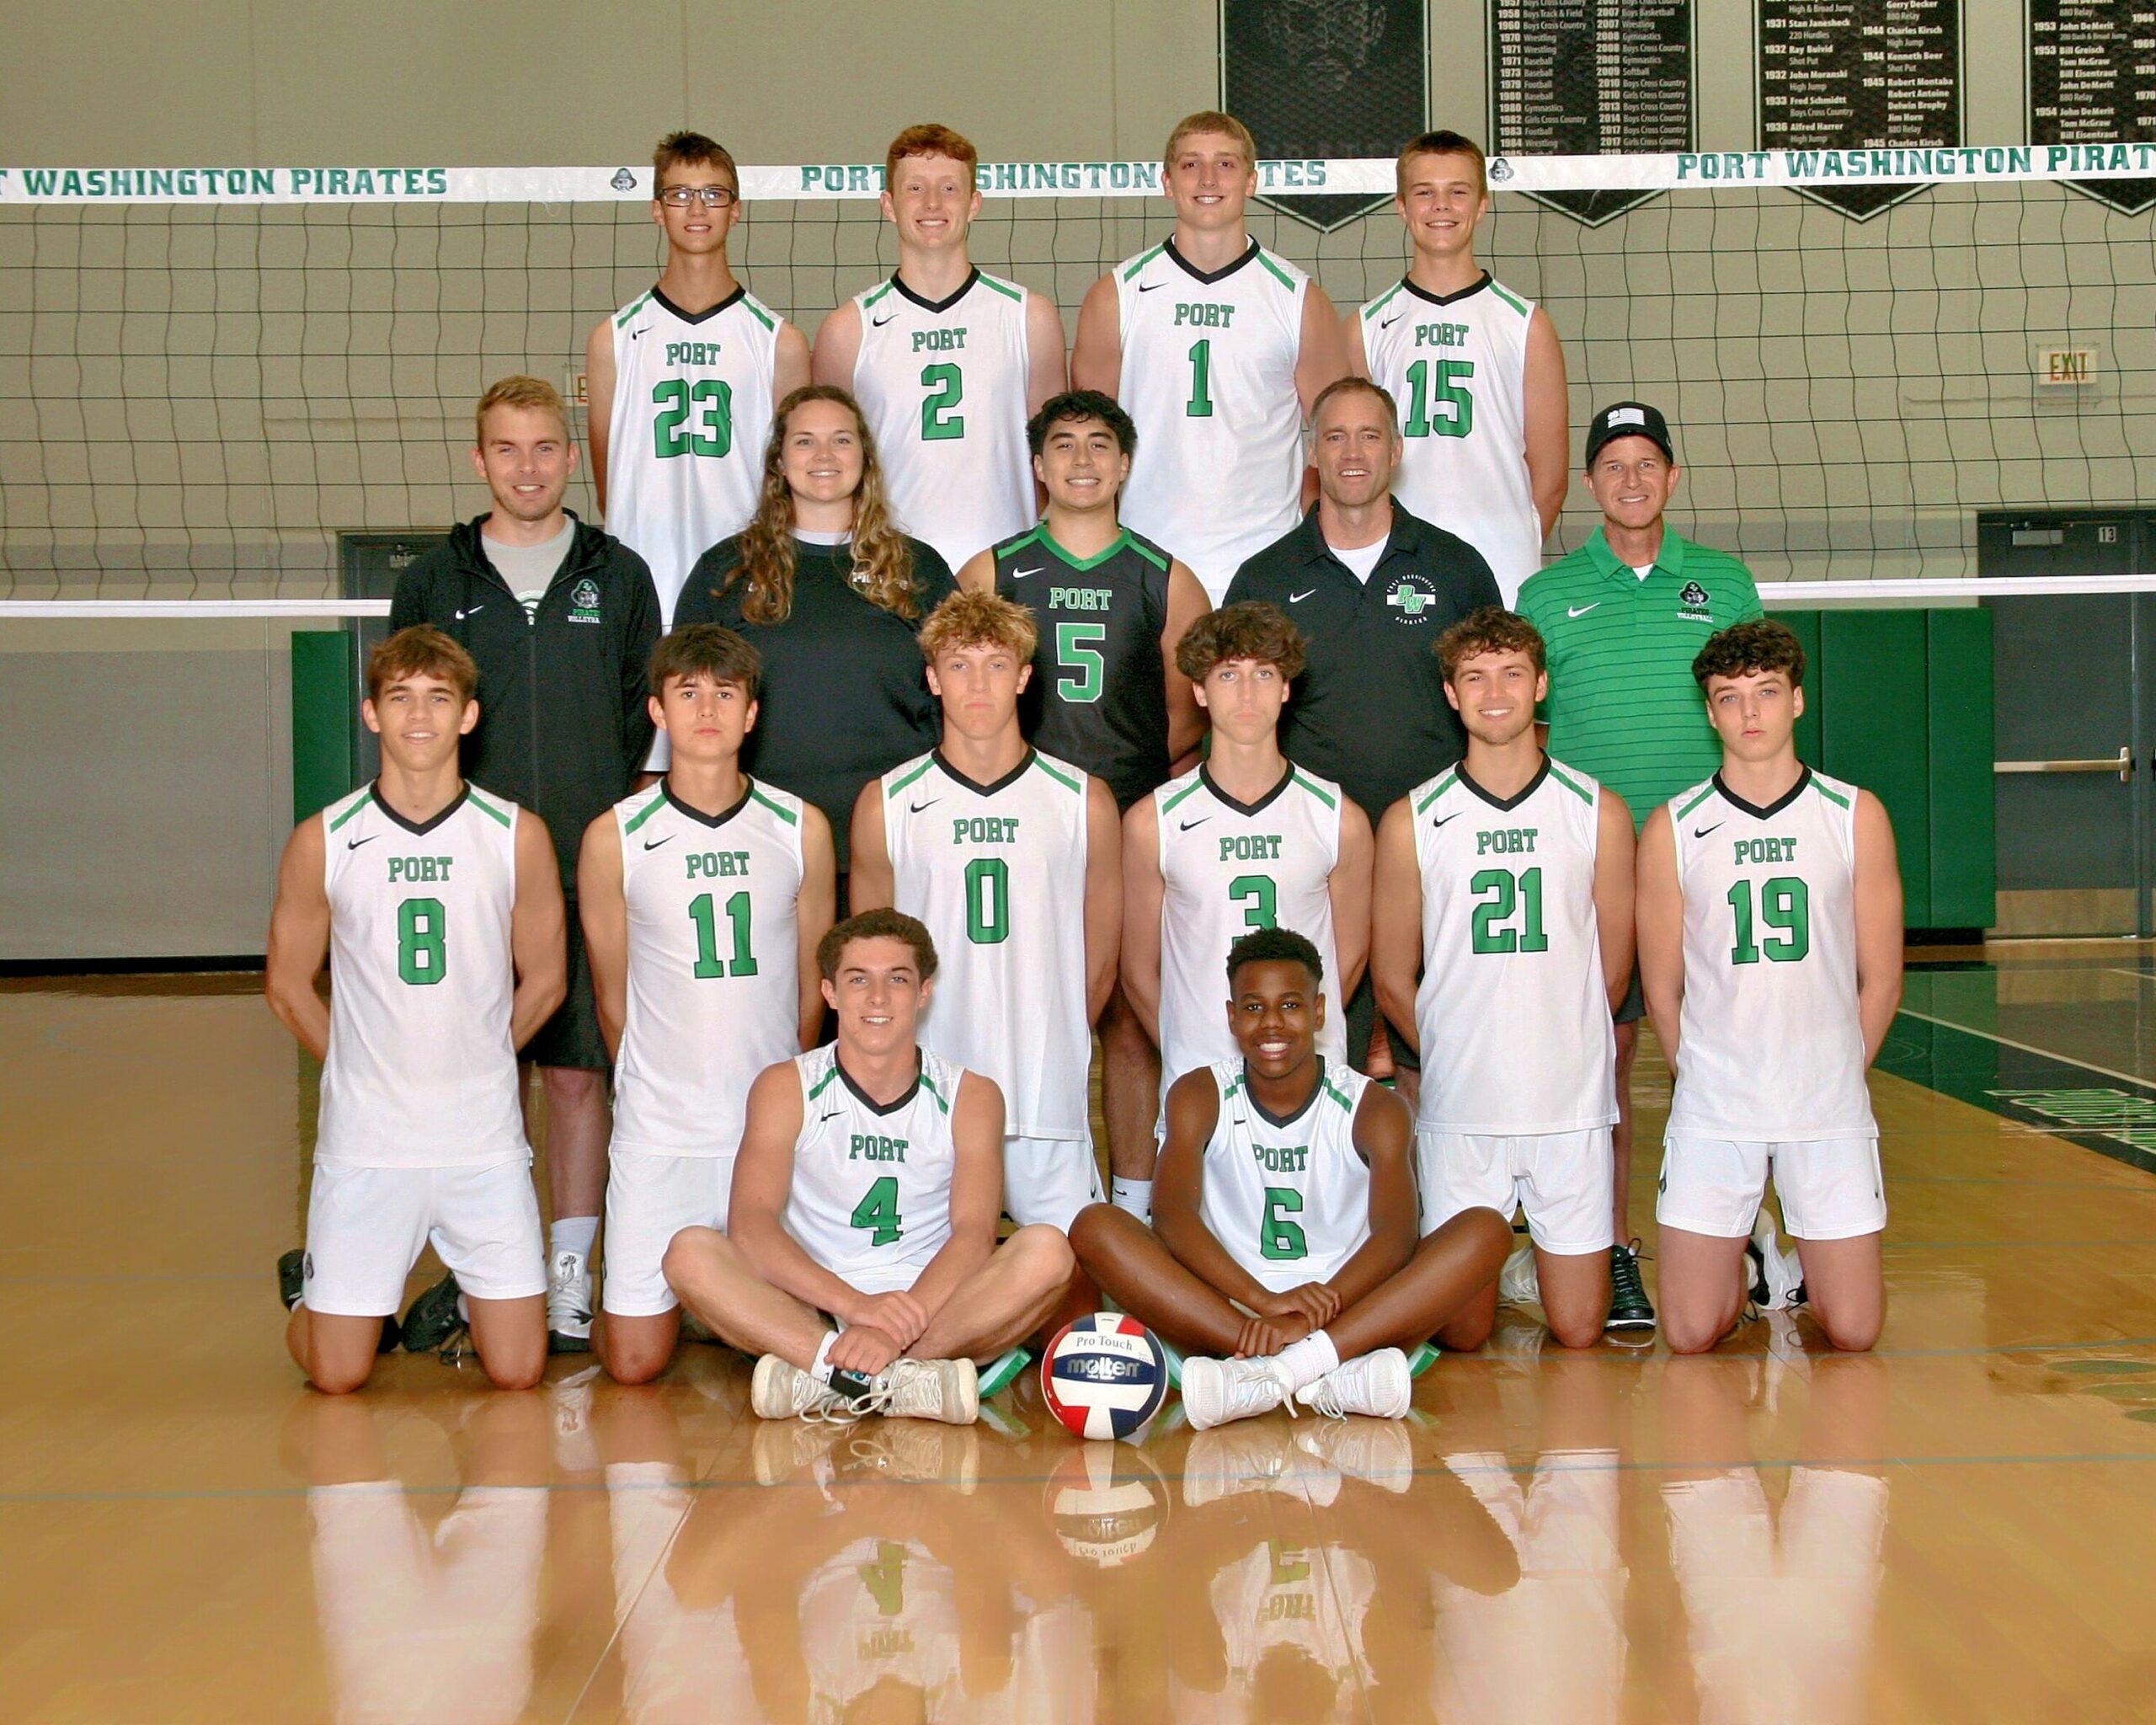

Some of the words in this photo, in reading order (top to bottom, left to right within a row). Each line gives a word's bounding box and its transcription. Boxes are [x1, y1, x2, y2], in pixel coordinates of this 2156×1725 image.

[1597, 8, 1620, 17] 2007
[1597, 19, 1619, 29] 2007
[1789, 19, 1808, 28] Stan
[1887, 26, 1917, 35] Charles
[1918, 25, 1943, 34] Kirsch
[2034, 21, 2056, 31] 1953
[2059, 22, 2079, 31] John
[1501, 45, 1521, 54] 1971
[1764, 45, 1786, 54] 1932
[1789, 45, 1805, 55] Ray
[1887, 52, 1922, 61] Kenneth
[2034, 45, 2056, 55] 1953
[2059, 46, 2073, 55] Bill
[1502, 56, 1521, 66] 1971
[2059, 58, 2077, 67] Tom
[2078, 57, 2111, 66] McGraw
[1500, 68, 1521, 77] 1973
[1765, 71, 1787, 79] 1932
[1790, 71, 1809, 79] John
[2059, 70, 2073, 78] Bill
[1598, 78, 1620, 88] 2010
[1659, 78, 1687, 88] Country
[2059, 82, 2079, 90] John
[1598, 90, 1620, 99] 2010
[1658, 90, 1686, 100] Country
[1917, 89, 1950, 98] Antoine
[1598, 102, 1620, 111] 2013
[1659, 102, 1687, 112] Country
[2035, 107, 2057, 116] 1954
[2060, 108, 2079, 116] John
[1499, 115, 1522, 124] 1982
[1599, 114, 1620, 123] 2014
[1659, 114, 1687, 124] Country
[1887, 113, 1903, 122] Jim
[2060, 120, 2078, 128] Tom
[2079, 119, 2111, 127] McGraw
[1500, 126, 1522, 136] 1983
[1600, 126, 1621, 135] 2017
[1659, 126, 1687, 136] Country
[1500, 138, 1522, 147] 1984
[1600, 137, 1621, 147] 2017
[1640, 137, 1657, 146] Cross
[1658, 137, 1686, 147] Country
[1888, 139, 1918, 147] Charles
[1919, 138, 1944, 147] Kirsch
[1677, 153, 1771, 179] PORT
[1785, 147, 2031, 178] WASHINGTON
[2047, 144, 2156, 172] PIRAT
[23, 169, 275, 195] WASHINGTON
[291, 168, 446, 195] PIRATES
[976, 163, 1156, 190] SHINGTON
[1174, 303, 1235, 328] PORT
[912, 328, 967, 352] PORT
[1416, 323, 1470, 346] PORT
[666, 342, 720, 366] PORT
[2050, 352, 2087, 381] EXIT
[1186, 339, 1213, 417] 1
[921, 362, 964, 441] 2
[1404, 359, 1474, 438] 15
[652, 379, 732, 458] 23
[2100, 528, 2115, 541] 13
[1049, 587, 1112, 611] PORT
[1056, 622, 1105, 702] 5
[953, 817, 1019, 845] PORT
[1219, 835, 1282, 861] PORT
[1476, 829, 1538, 855] PORT
[1734, 838, 1796, 865] PORT
[387, 857, 453, 882] PORT
[686, 851, 750, 879] PORT
[964, 857, 1009, 944] 0
[1229, 875, 1277, 948] 3
[1470, 868, 1548, 954] 21
[1727, 877, 1809, 964] 19
[398, 898, 446, 985] 8
[688, 891, 758, 979] 11
[848, 1134, 910, 1162] PORT
[1251, 1144, 1308, 1172] PORT
[850, 1176, 903, 1247] 4
[1260, 1187, 1308, 1260] 6
[1076, 1337, 1095, 1347] Pro
[1098, 1335, 1133, 1350] Touch
[1067, 1357, 1139, 1377] molten
